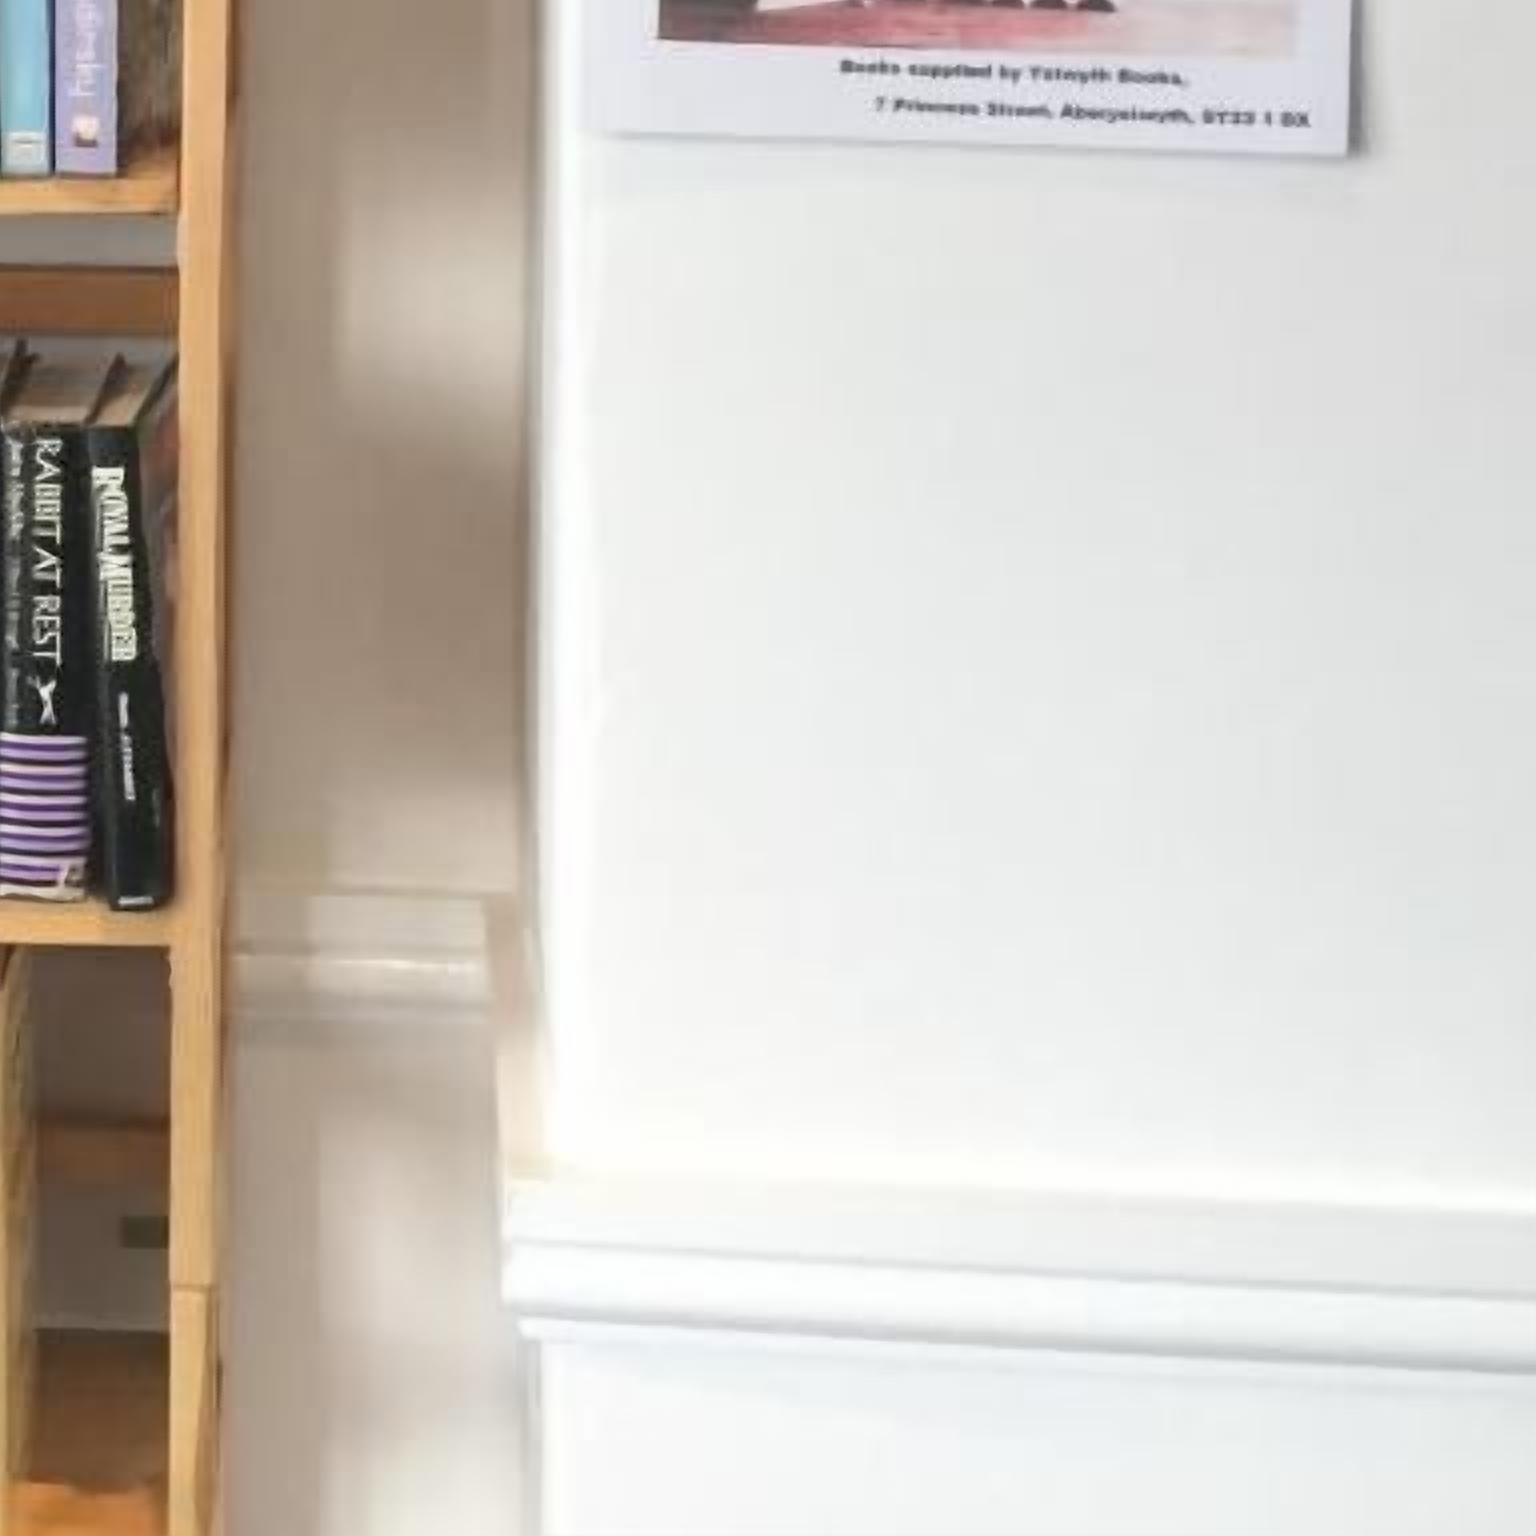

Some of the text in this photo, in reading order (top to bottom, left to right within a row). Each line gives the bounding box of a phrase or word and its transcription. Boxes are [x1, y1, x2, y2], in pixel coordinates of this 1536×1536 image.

[839, 58, 901, 74] Books
[908, 62, 993, 79] supplied
[999, 63, 1022, 85] by
[892, 97, 980, 116] Princess
[30, 437, 63, 667] RABBIT AT REST
[90, 464, 130, 553] ROYAL
[97, 550, 139, 663] MURDER
